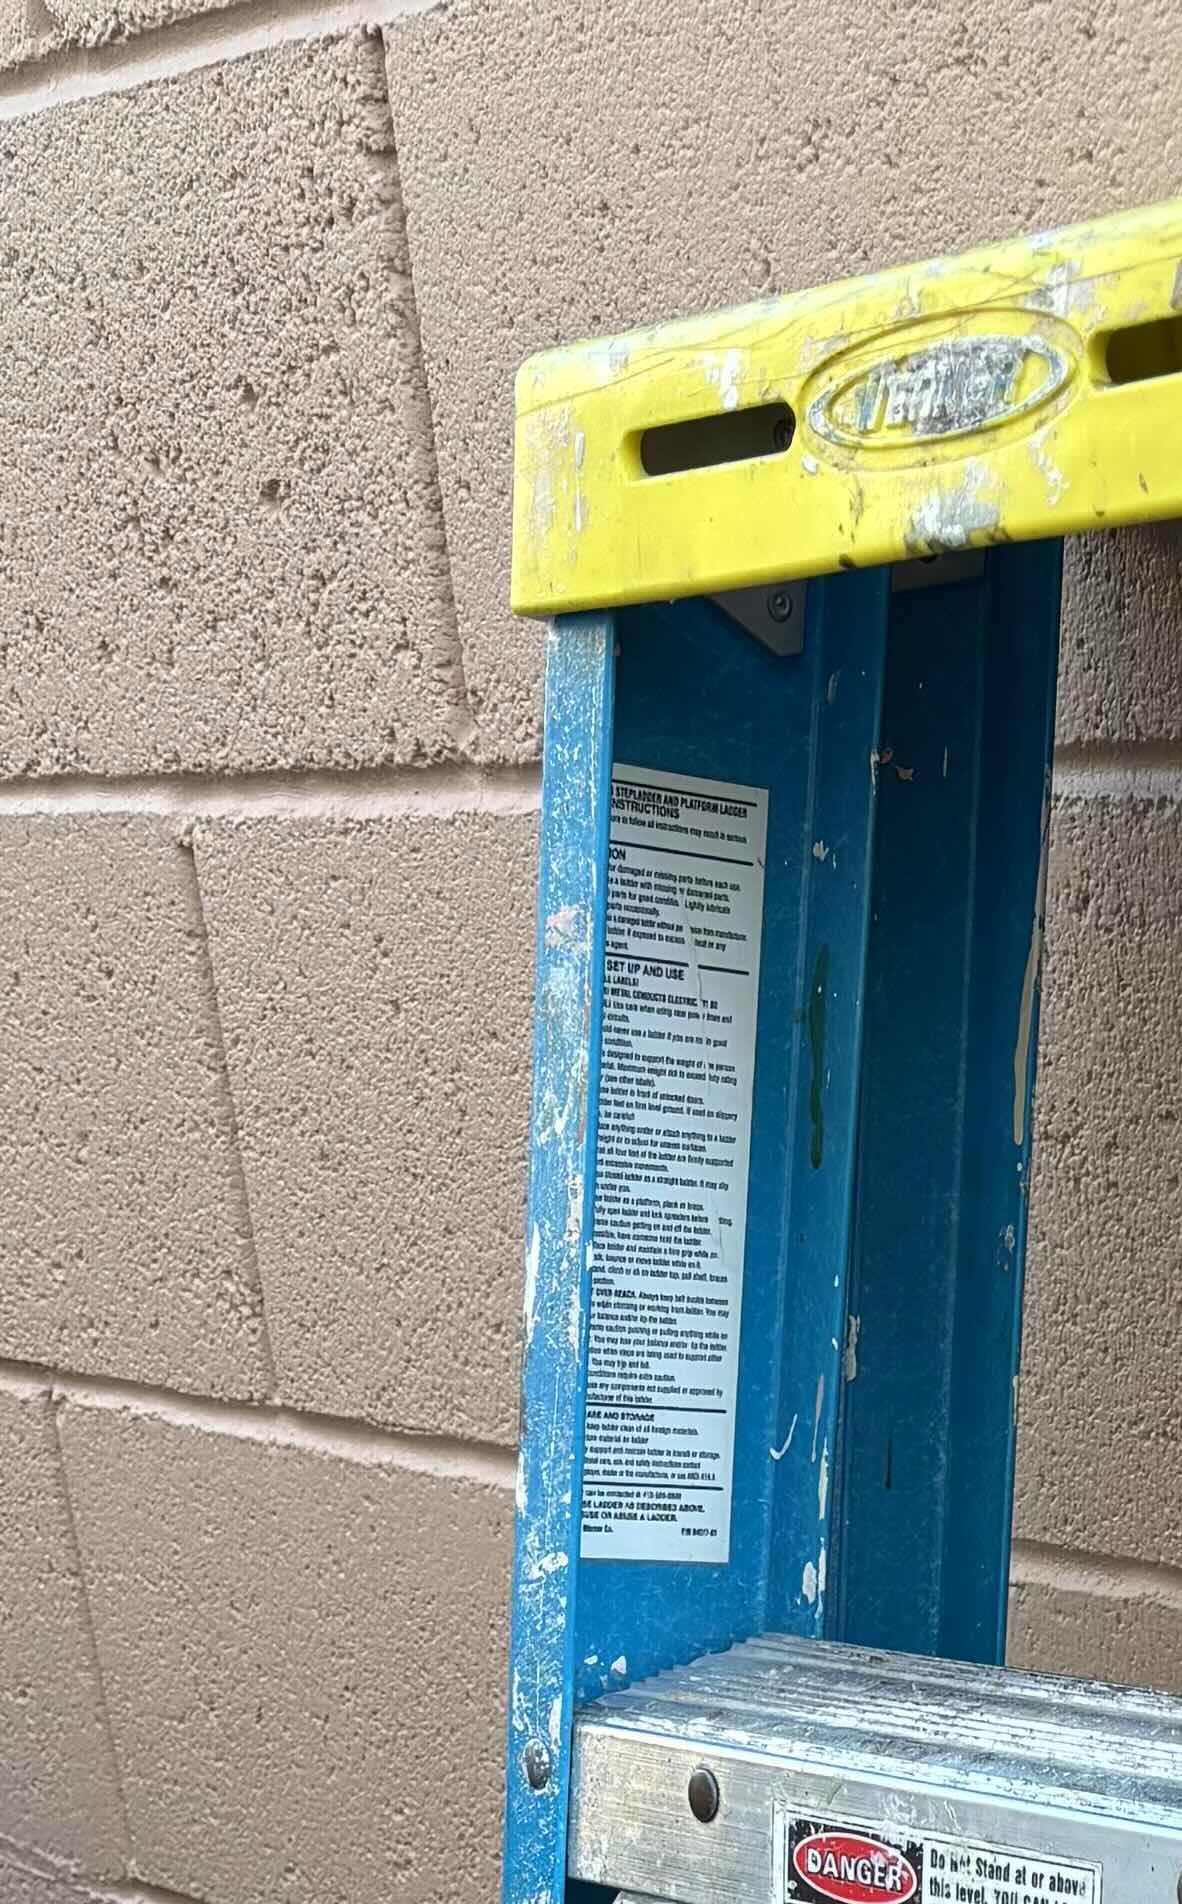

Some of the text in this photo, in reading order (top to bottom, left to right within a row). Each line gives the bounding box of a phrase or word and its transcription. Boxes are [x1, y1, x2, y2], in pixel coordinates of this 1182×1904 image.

[611, 798, 680, 819] NSTRUCTIONS
[663, 795, 679, 808] AND
[680, 799, 719, 815] PLATFORM
[606, 960, 685, 981] SET UP AND USE
[805, 1847, 903, 1893] DANGER
[930, 1848, 945, 1870] Do
[975, 1857, 1011, 1883] Stand
[1015, 1865, 1027, 1886] at
[1031, 1870, 1045, 1889] or
[1048, 1872, 1086, 1897] above
